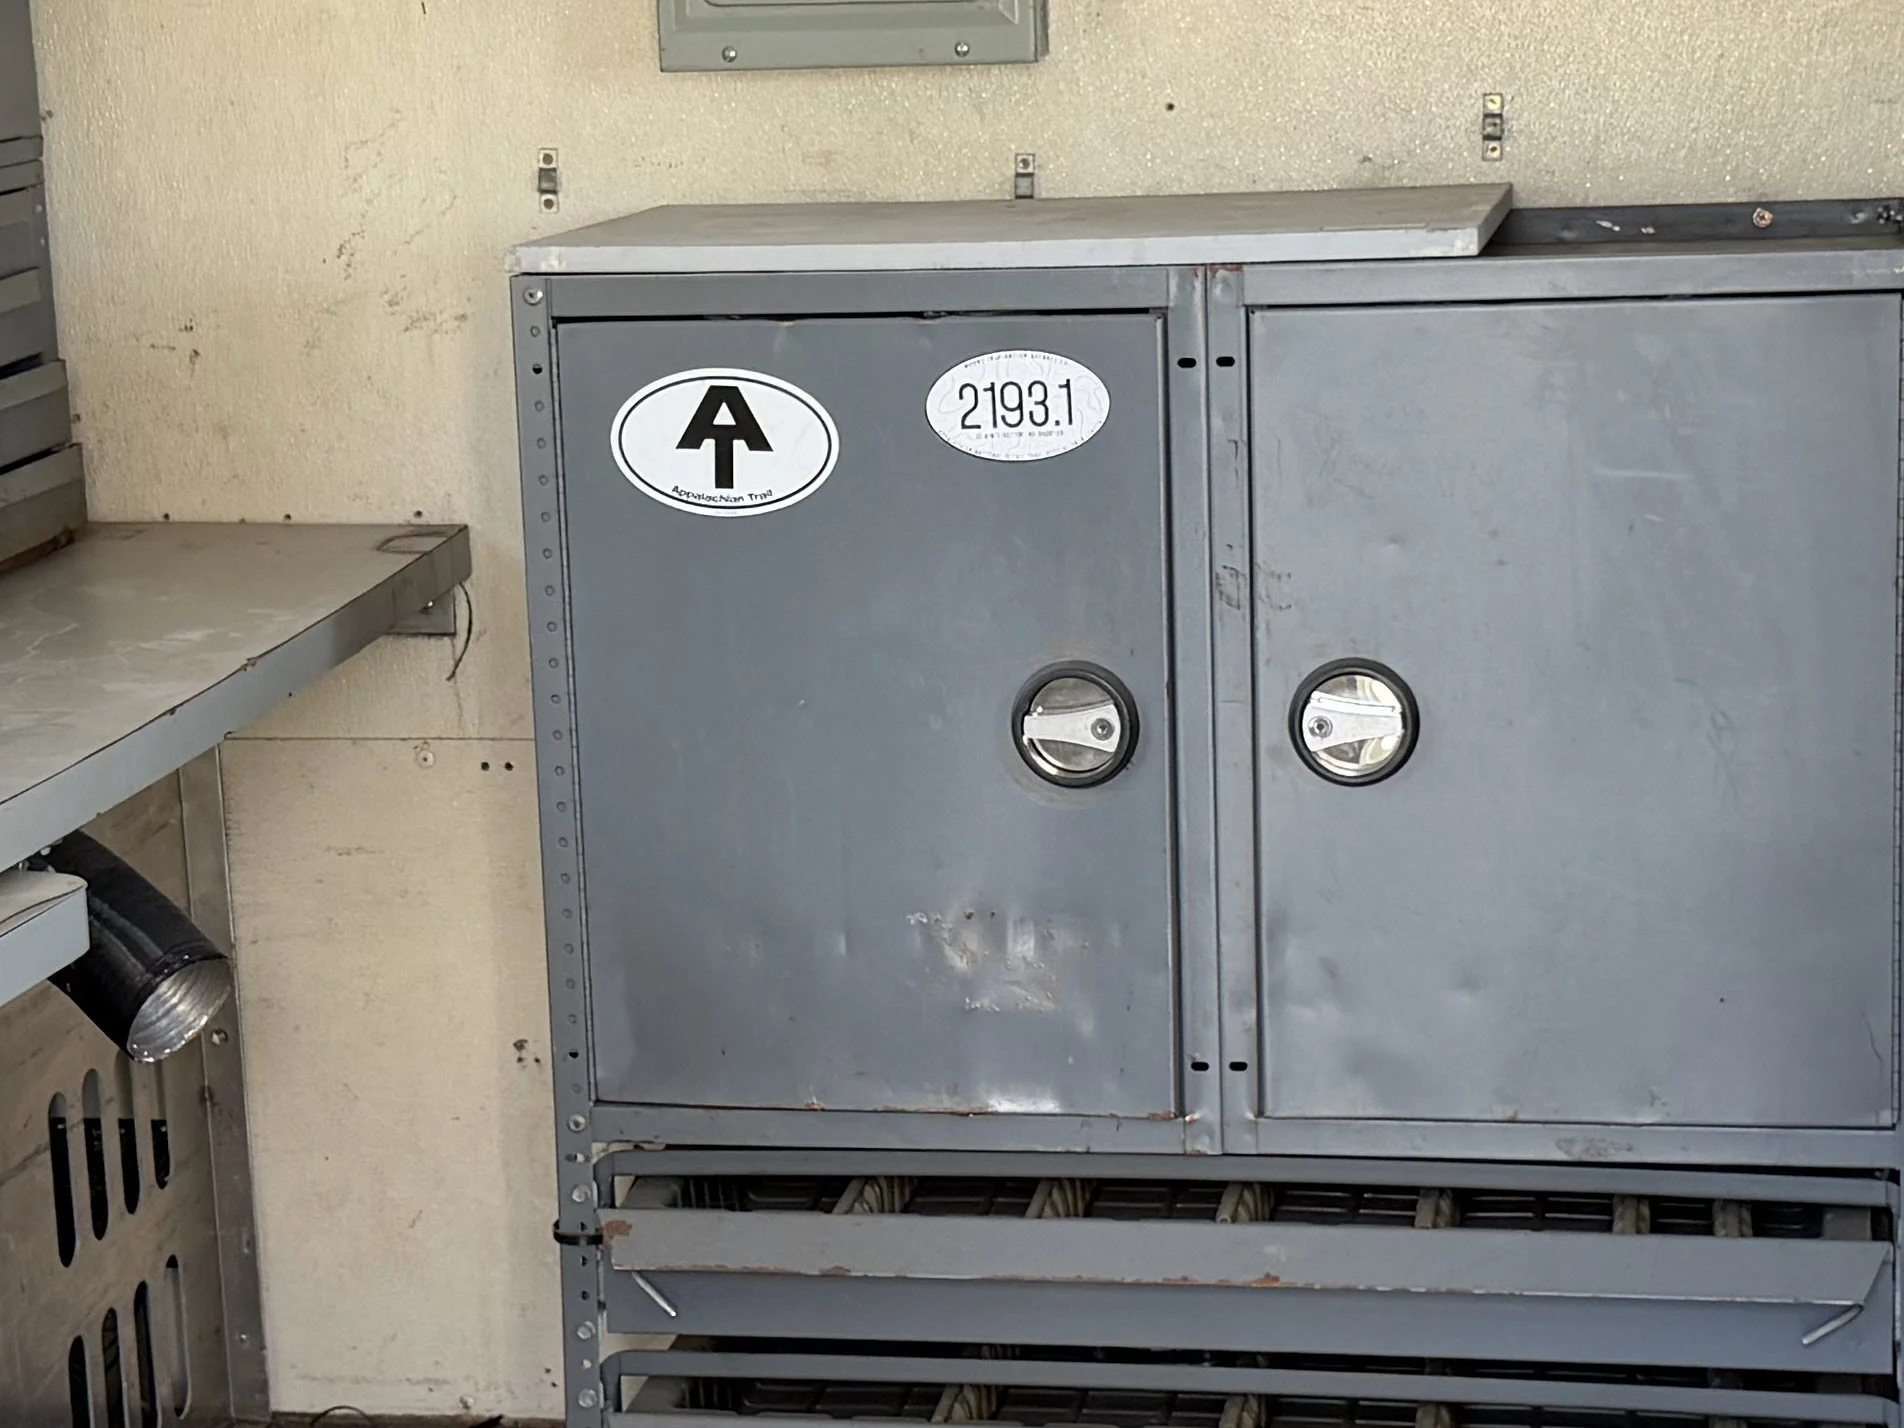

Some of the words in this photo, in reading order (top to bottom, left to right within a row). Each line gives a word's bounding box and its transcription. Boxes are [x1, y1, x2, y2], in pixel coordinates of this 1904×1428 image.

[959, 378, 1073, 430] 2193.1
[671, 485, 744, 503] Appalachian
[747, 489, 773, 501] Trail
